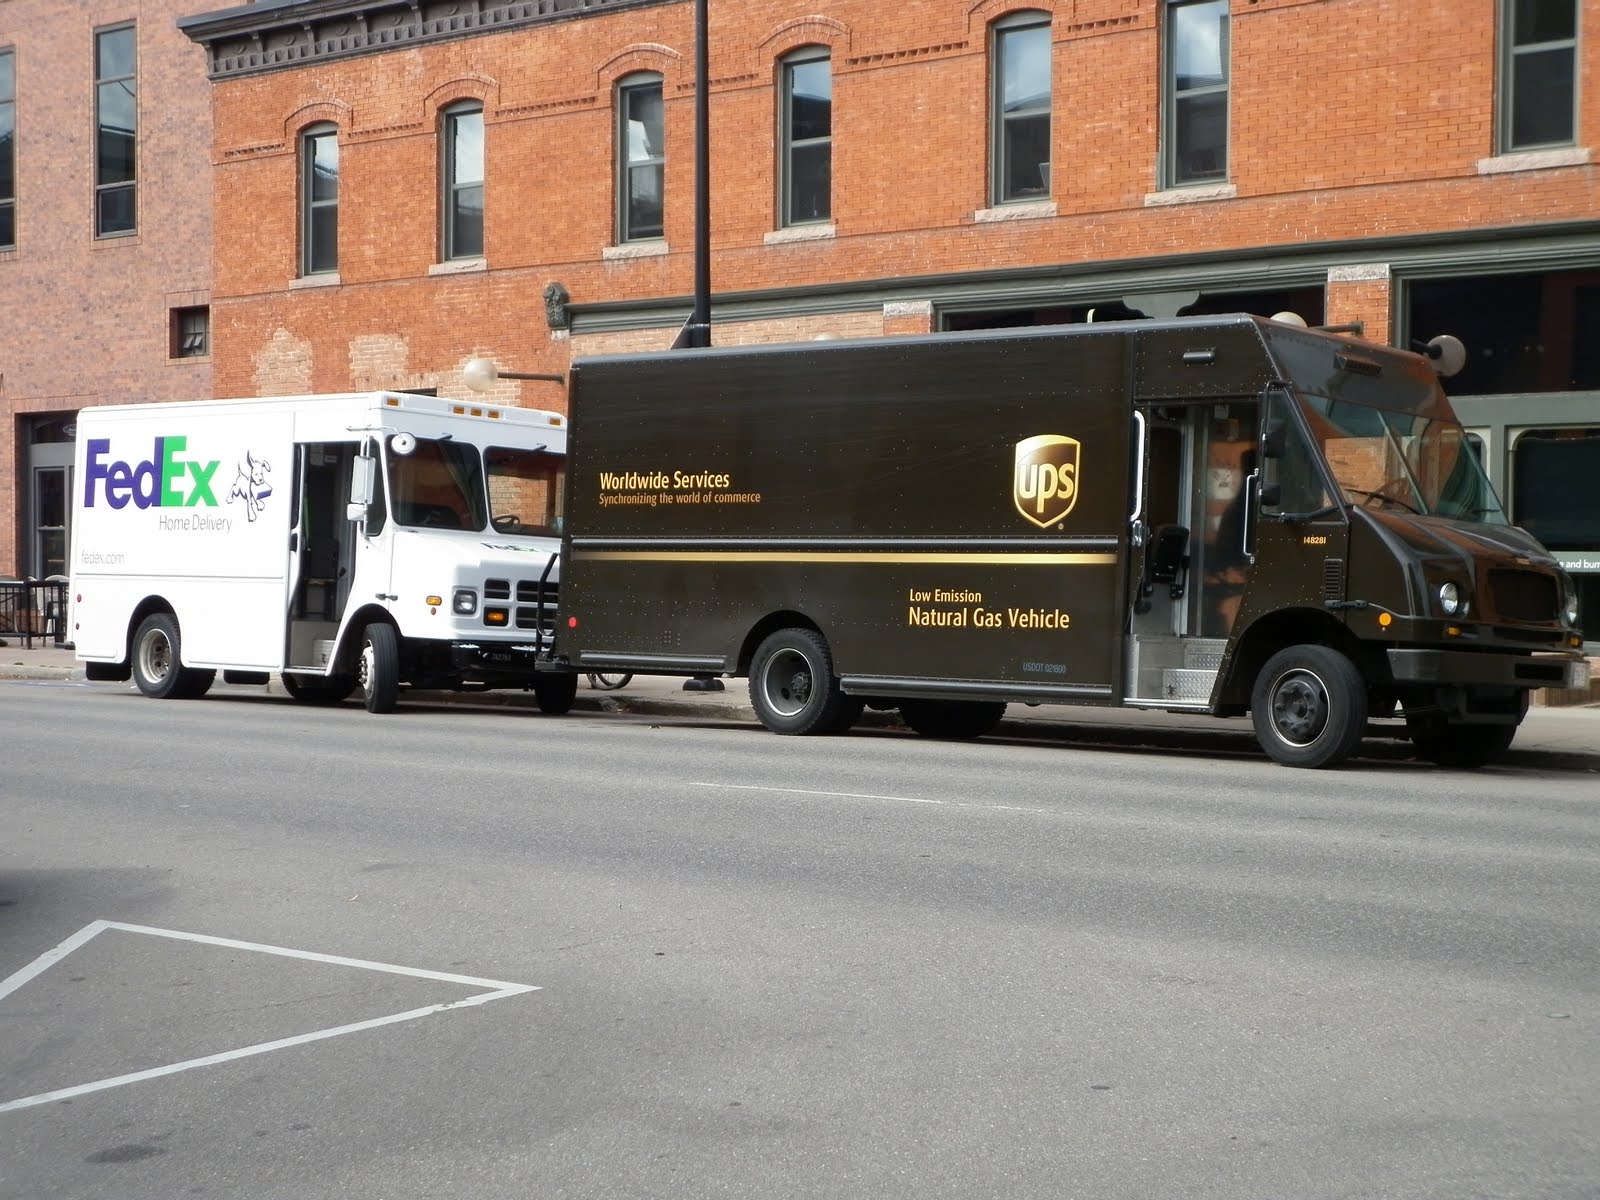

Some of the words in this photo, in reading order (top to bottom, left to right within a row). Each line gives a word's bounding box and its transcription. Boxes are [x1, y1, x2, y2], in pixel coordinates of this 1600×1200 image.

[84, 436, 221, 510] FedEx
[600, 471, 669, 490] Worldwide
[673, 470, 730, 489] Services
[599, 492, 657, 507] Synchronizing
[659, 493, 673, 504] the
[676, 492, 700, 504] world
[702, 491, 712, 503] of
[714, 492, 761, 503] commerce
[159, 515, 190, 531] Home
[192, 514, 233, 534] Delivery
[1303, 536, 1327, 544] 148281
[81, 549, 125, 565] fedex.com
[1565, 559, 1582, 568] and
[909, 588, 932, 602] Low
[934, 589, 982, 602] Emission
[908, 607, 967, 626] Natural
[973, 608, 1003, 628] Gas
[1008, 608, 1070, 628] Vehicle
[1022, 662, 1044, 672] USDOT
